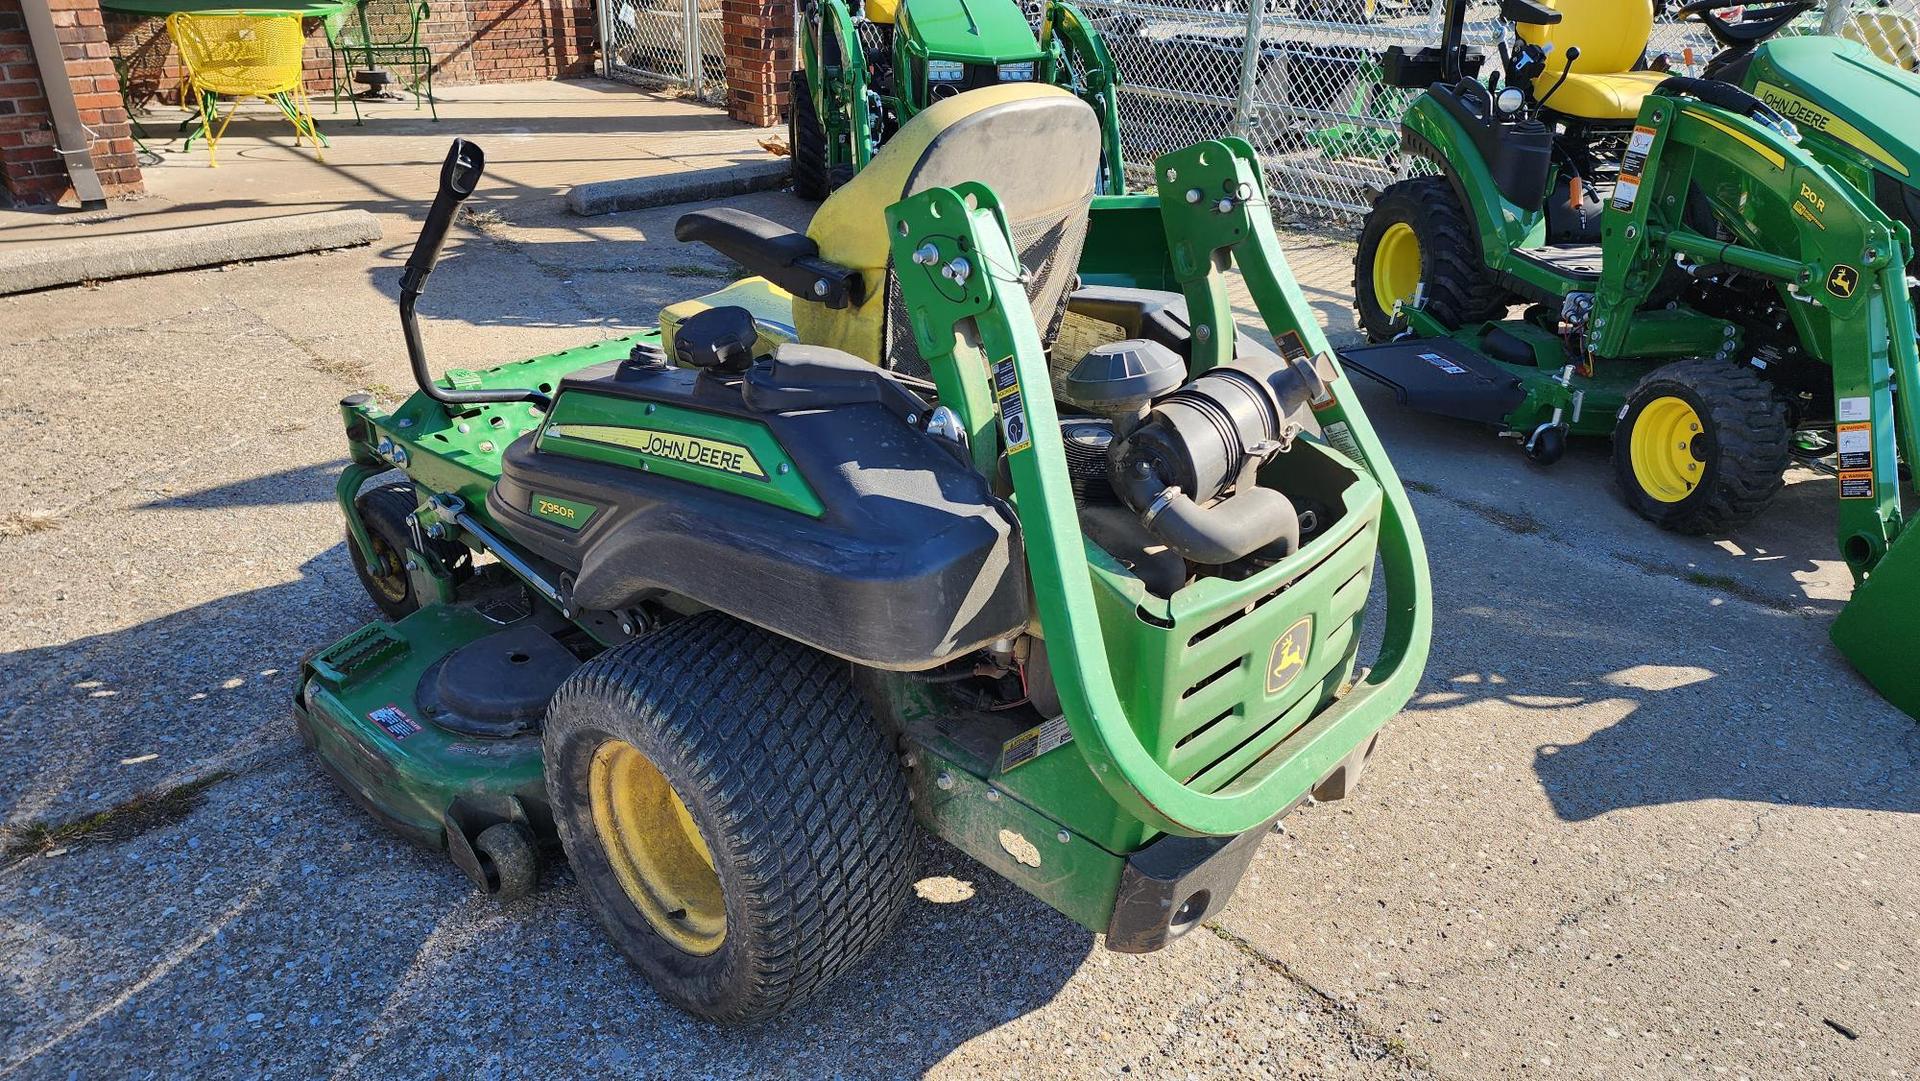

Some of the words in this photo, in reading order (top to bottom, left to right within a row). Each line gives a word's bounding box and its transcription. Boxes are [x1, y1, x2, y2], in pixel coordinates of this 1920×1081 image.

[1762, 90, 1790, 114] JOHN
[1788, 101, 1830, 129] DEERE
[642, 433, 685, 457] JOHN
[688, 441, 744, 470] DEERE
[539, 500, 575, 519] Z950R
